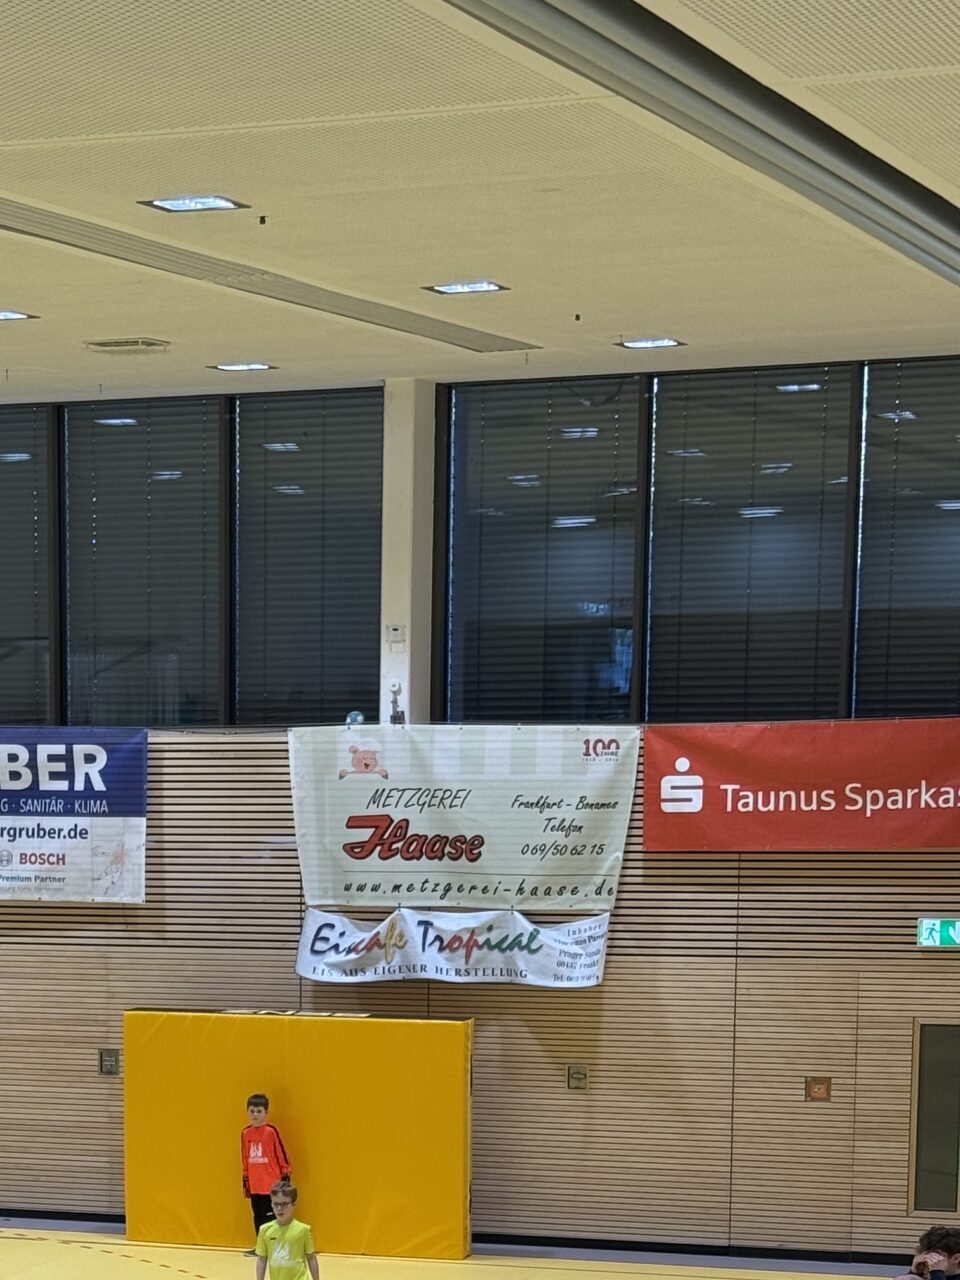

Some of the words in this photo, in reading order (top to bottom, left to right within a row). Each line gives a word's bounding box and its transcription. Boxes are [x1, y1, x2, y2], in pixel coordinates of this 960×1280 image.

[19, 796, 64, 813] SANITÄR
[74, 799, 109, 814] KLIMA
[366, 788, 471, 813] METZGEREI
[511, 794, 564, 814] Frankfurt
[575, 795, 619, 810] Bonames
[720, 783, 836, 812] Taunus
[844, 779, 960, 817] Sparka
[342, 814, 484, 862] Haase
[543, 817, 584, 838] Telefon
[19, 853, 66, 865] BOSCH
[34, 875, 66, 883] Partner
[344, 877, 615, 900] www.metzgerei-haase.de
[417, 920, 544, 965] Tropical
[312, 966, 334, 977] EIS
[374, 964, 428, 976] EIGENER
[435, 965, 528, 979] HERSTELLUNG
